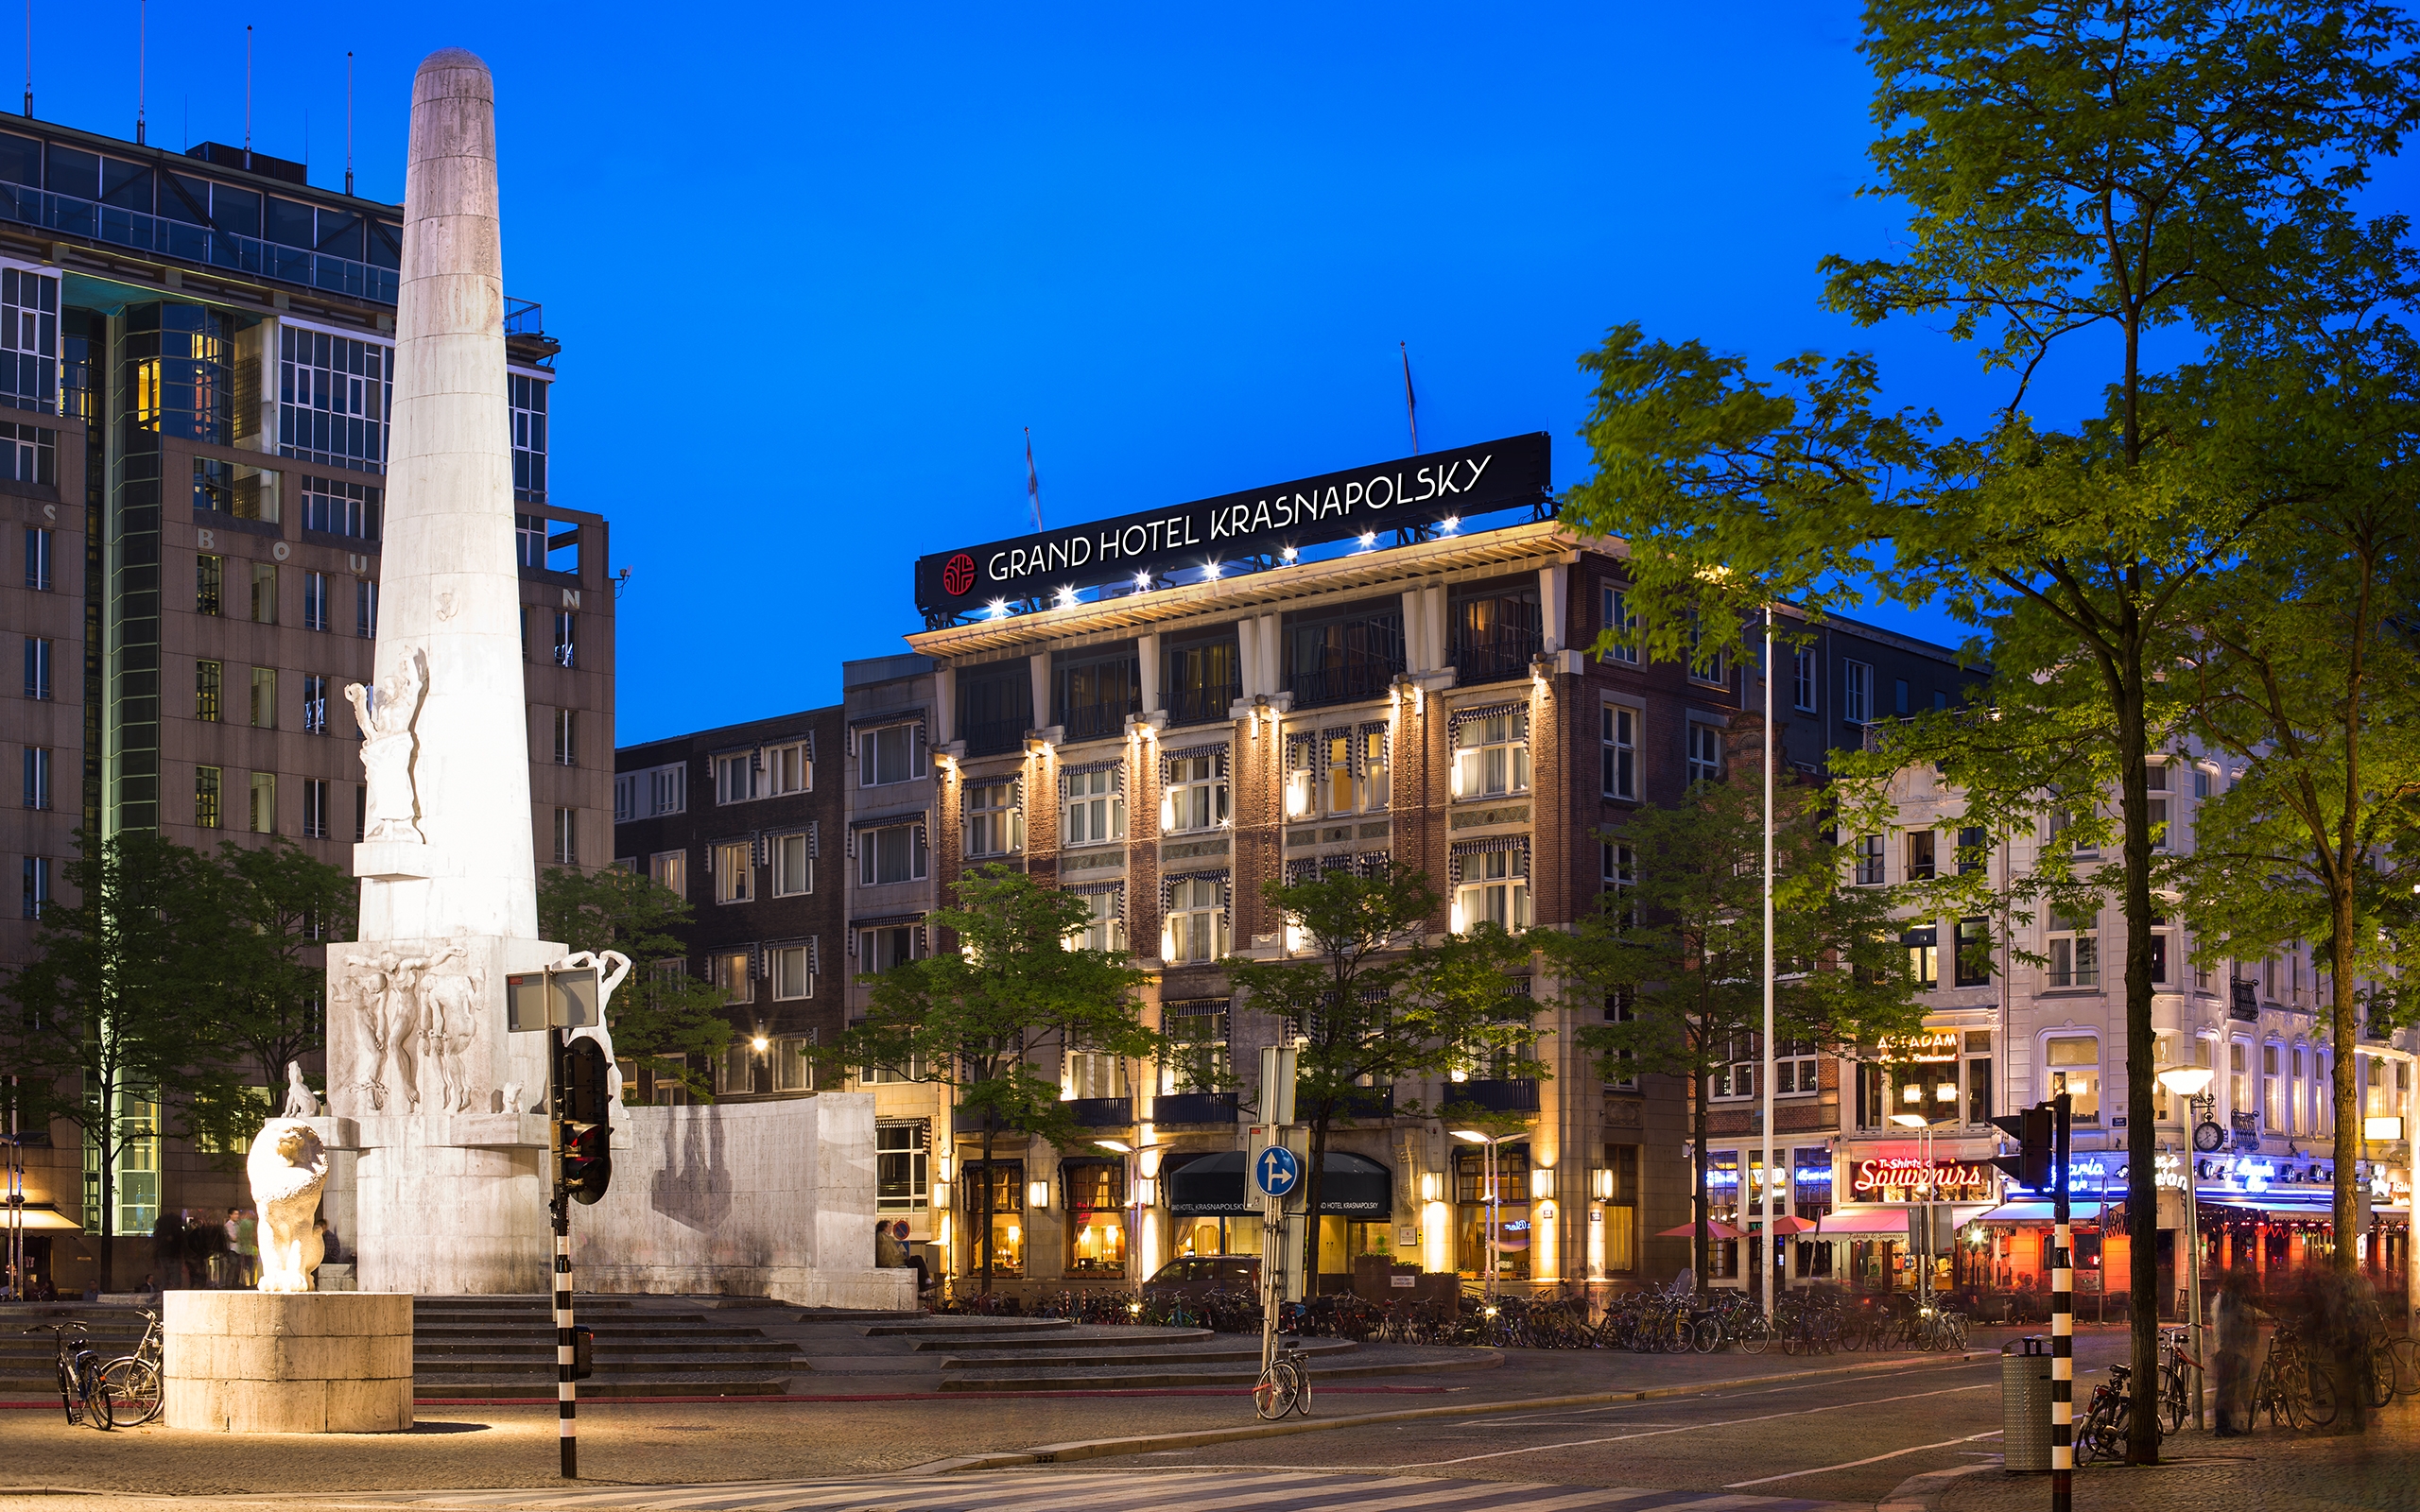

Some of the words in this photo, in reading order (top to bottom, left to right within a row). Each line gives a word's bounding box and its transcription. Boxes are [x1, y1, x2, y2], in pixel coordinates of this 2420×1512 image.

[988, 536, 1093, 582] GRAND
[1099, 515, 1200, 561] HOTEL
[1210, 454, 1493, 539] KRASNAPOLSKY
[1855, 1158, 1981, 1191] Souvenirs
[1343, 1201, 1379, 1210] KRASNAPOLSKY
